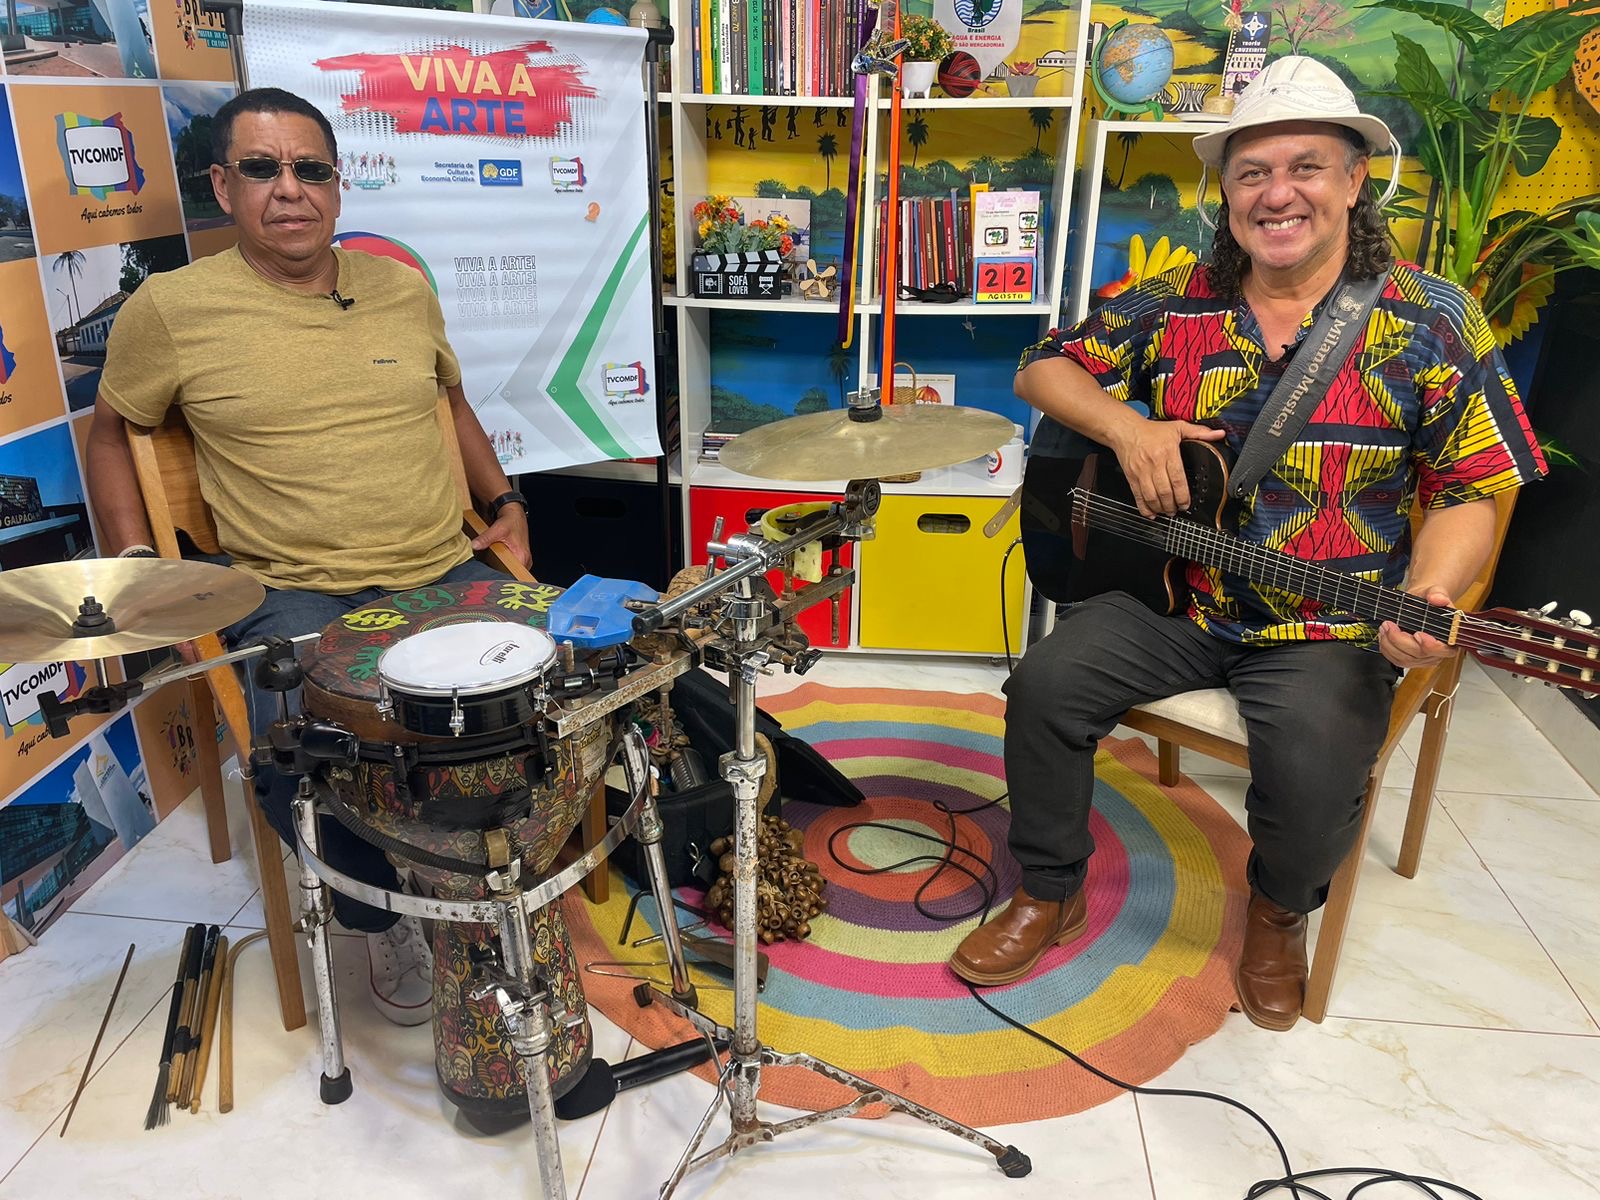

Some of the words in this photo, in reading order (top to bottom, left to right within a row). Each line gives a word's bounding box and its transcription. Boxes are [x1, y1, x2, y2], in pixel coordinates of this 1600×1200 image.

[400, 55, 502, 95] VIVA
[508, 63, 537, 97] A
[420, 97, 527, 135] ARTE
[70, 147, 124, 165] TVCOMDF
[500, 168, 518, 176] GDF
[81, 207, 97, 224] Aqui
[98, 204, 126, 218] cabemos
[126, 201, 142, 214] todos
[454, 256, 485, 272] VIVA
[488, 256, 498, 271] A
[500, 255, 536, 270] ARTE!
[455, 272, 486, 287] VIVA
[490, 272, 498, 286] A
[501, 270, 537, 285] ARTE!
[728, 273, 748, 286] SOFÁ
[985, 268, 999, 287] 2
[1012, 266, 1026, 286] 2
[728, 286, 748, 294] LOVER
[1308, 318, 1347, 374] Milano
[606, 375, 638, 383] TVCOMDF
[1268, 375, 1315, 438] Musical
[4, 511, 33, 527] GALPÃO
[3, 661, 64, 706] TVCOMDF
[18, 736, 36, 756] Aqui
